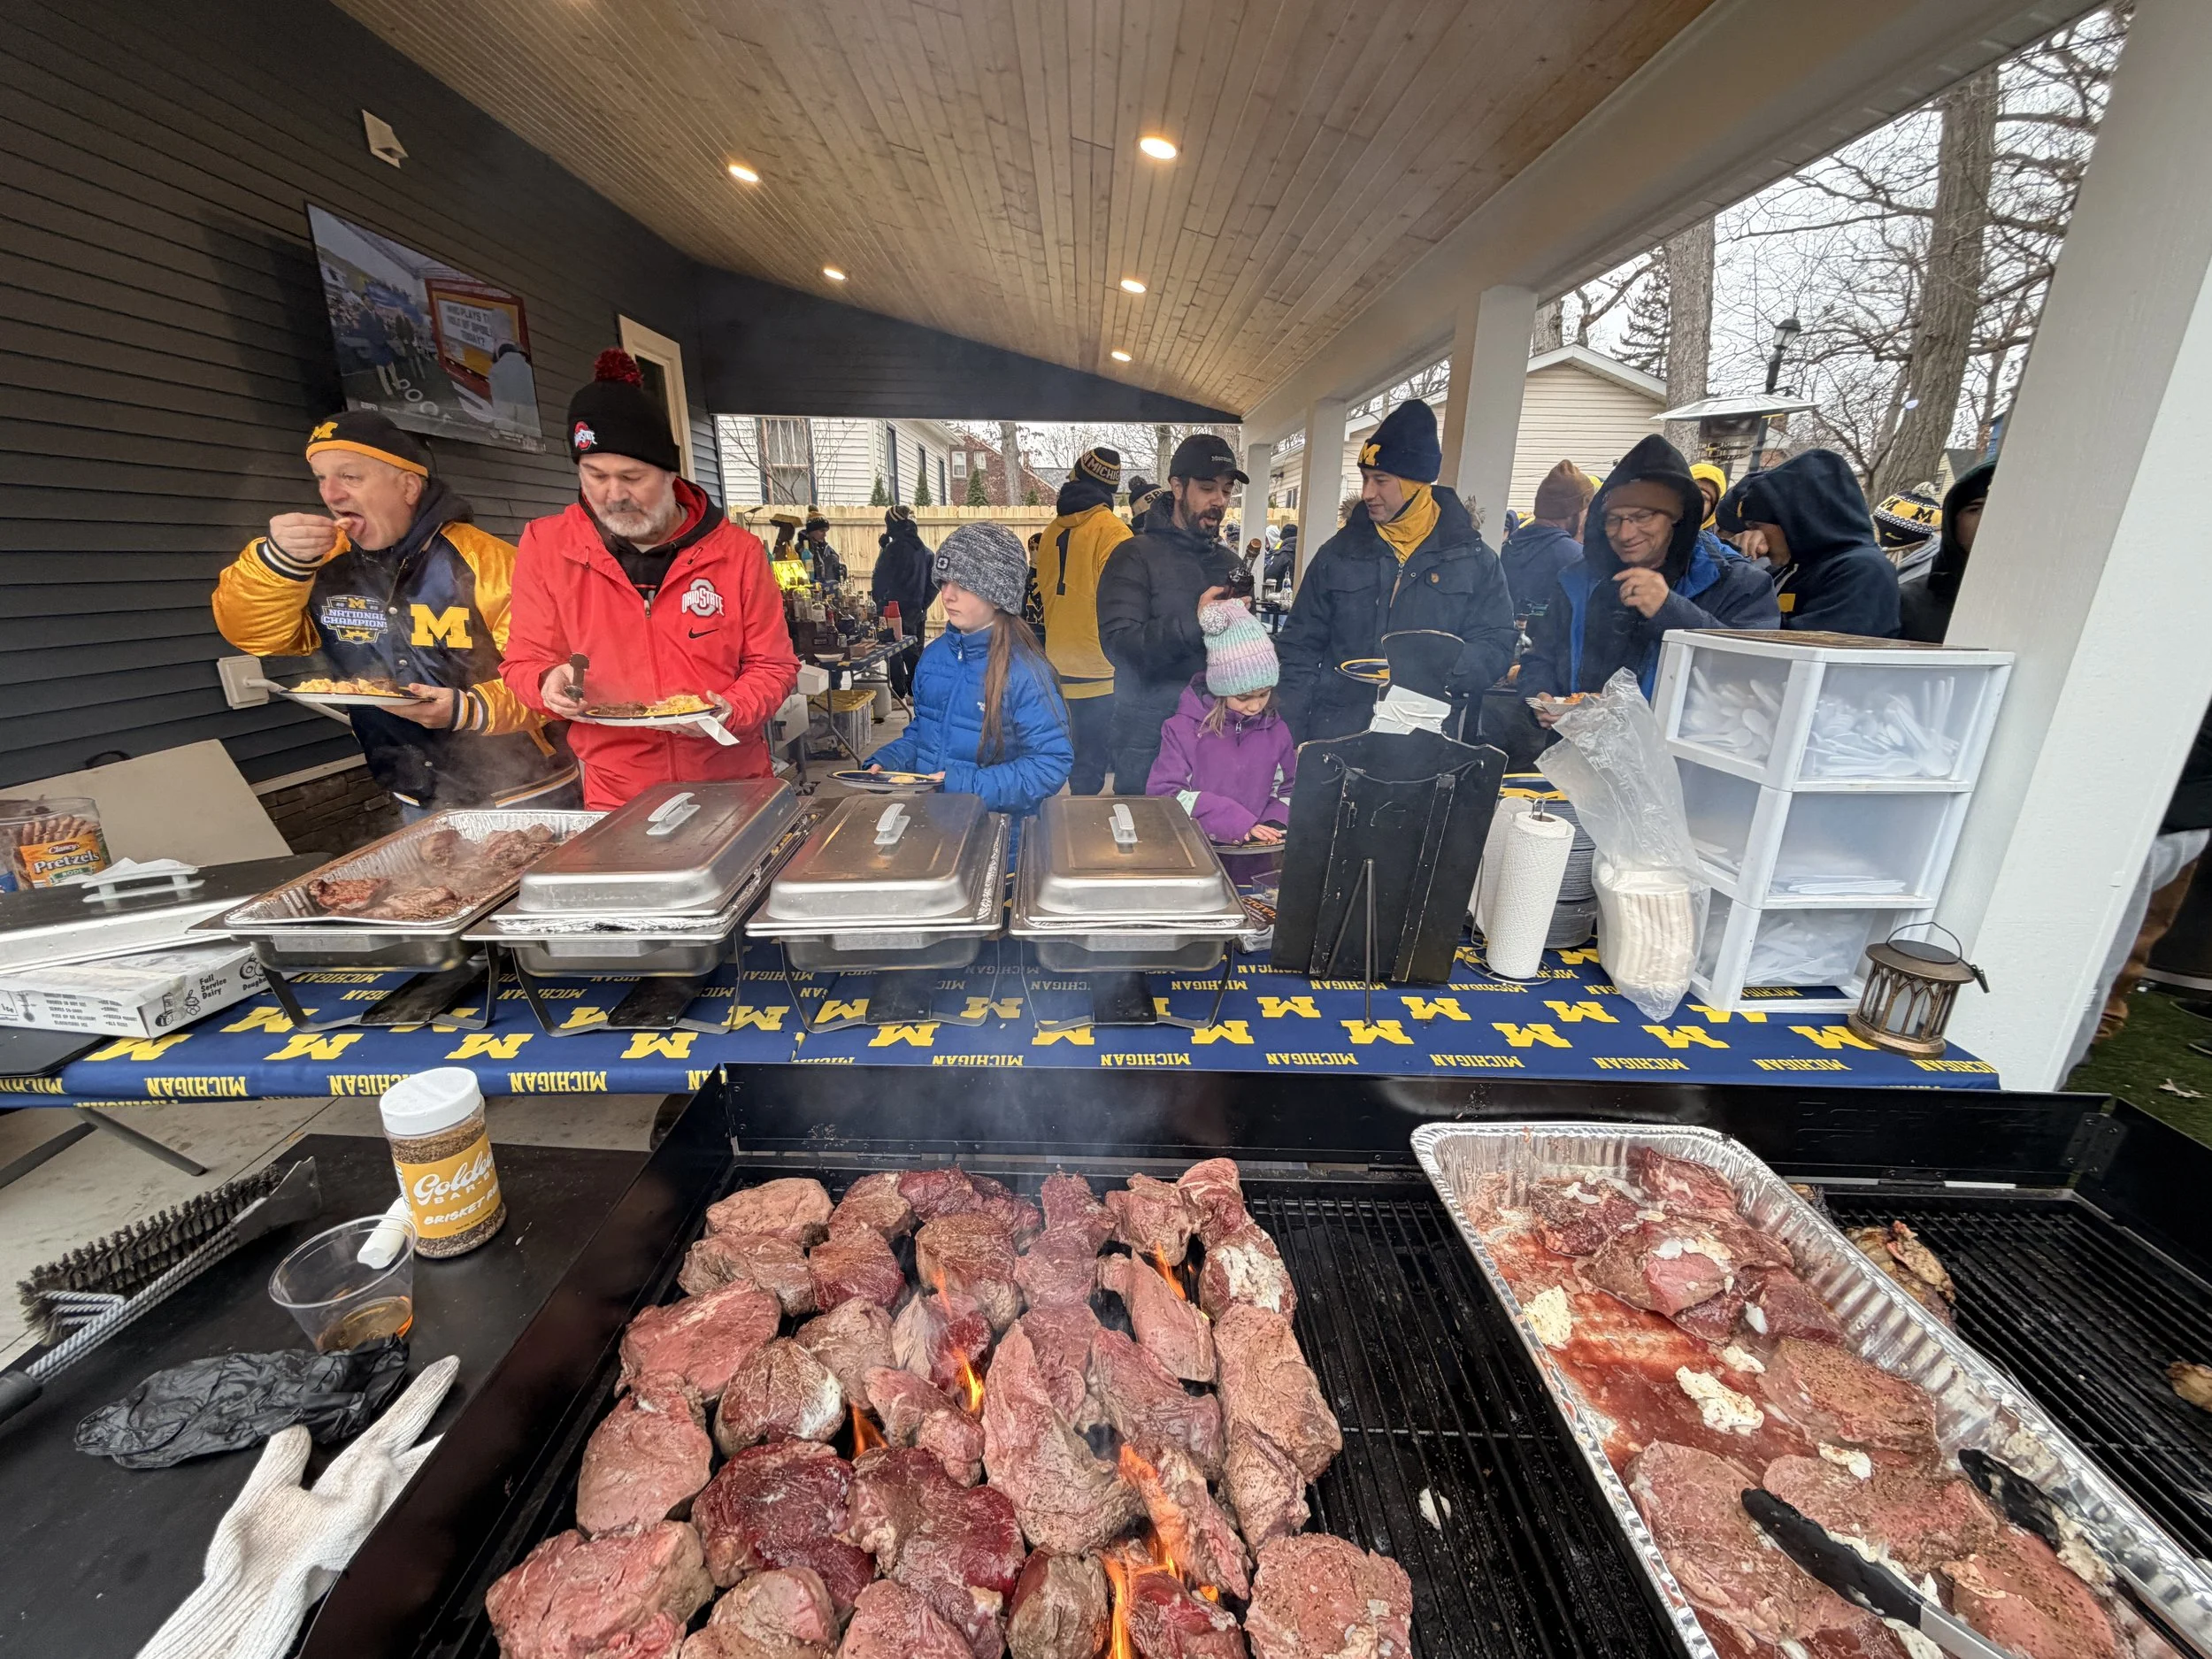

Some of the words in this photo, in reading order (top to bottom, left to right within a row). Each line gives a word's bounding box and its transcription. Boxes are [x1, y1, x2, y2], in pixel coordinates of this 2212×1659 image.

[1358, 442, 1381, 466] M
[1910, 506, 1935, 524] M
[1056, 528, 1071, 595] 1
[348, 596, 367, 610] M
[328, 609, 387, 621] NATIONAL
[410, 603, 473, 649] M
[34, 849, 100, 874] Pretzels
[199, 973, 214, 985] Full
[200, 978, 227, 993] Service
[202, 988, 222, 999] Dairy
[720, 1005, 790, 1031] M
[960, 997, 1024, 1019] M
[1258, 996, 1322, 1018] M
[1398, 996, 1471, 1021] M
[1543, 1000, 1620, 1023] M
[868, 1022, 941, 1048] M
[1339, 1018, 1415, 1045] M
[1490, 1022, 1573, 1048] M
[1641, 1025, 1731, 1049] M
[86, 1033, 193, 1062] M
[263, 1033, 365, 1061] M
[444, 1032, 534, 1060] M
[621, 1032, 699, 1060] M
[932, 1055, 1025, 1066] MICHIGAN
[1101, 1053, 1192, 1066] MICHIGAN
[1264, 1053, 1359, 1066] MICHIGAN
[1428, 1053, 1526, 1068] MICHIGAN
[1593, 1056, 1690, 1070] MICHIGAN
[1751, 1058, 1853, 1071] MICHIGAN
[146, 1076, 249, 1097] MICHIGAN
[510, 1071, 609, 1094] MICHIGAN
[423, 1195, 486, 1225] BRISKET
